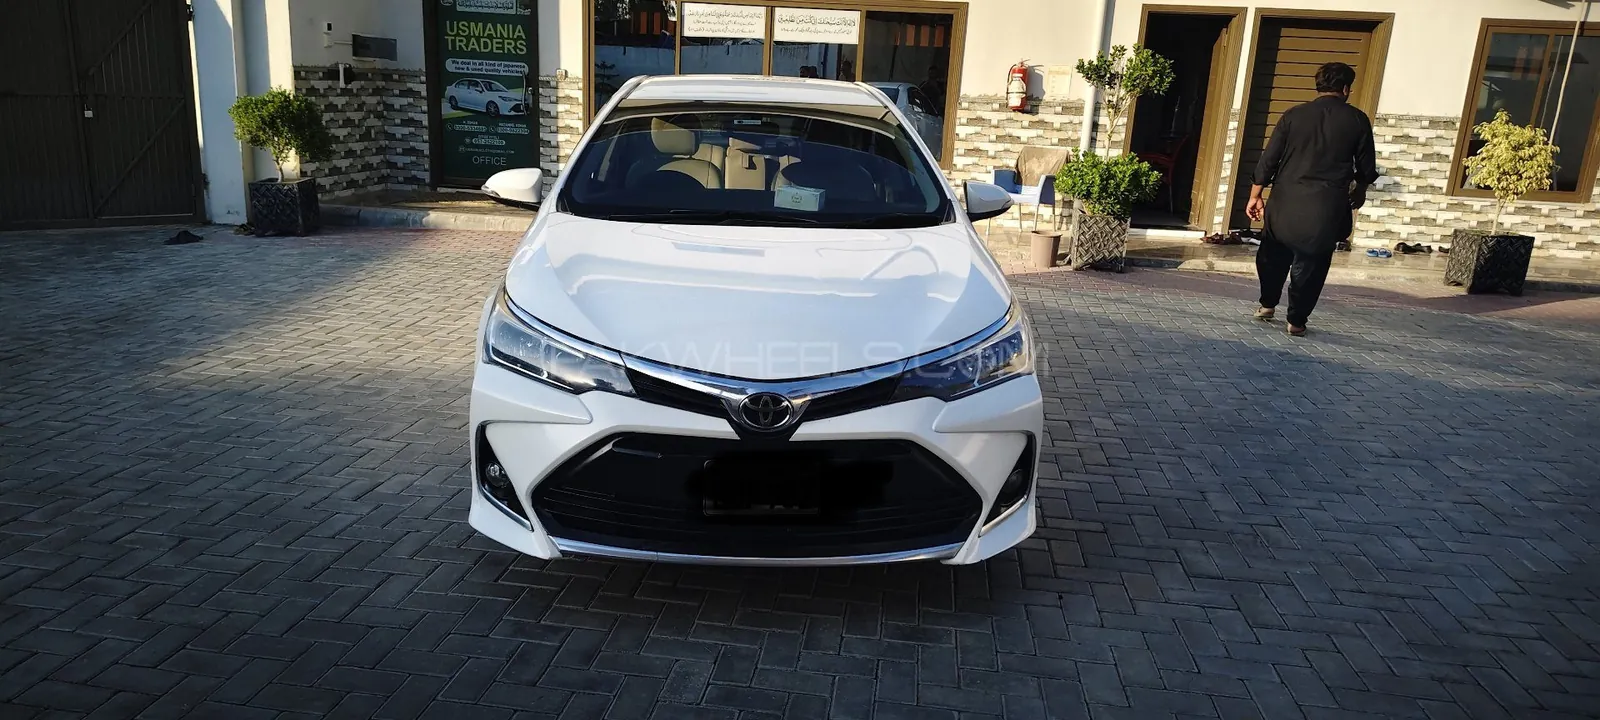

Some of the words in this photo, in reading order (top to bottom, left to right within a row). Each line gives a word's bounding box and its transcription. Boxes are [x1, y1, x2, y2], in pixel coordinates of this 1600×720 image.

[446, 20, 526, 39] USMANIA
[444, 36, 527, 55] TRADERS
[472, 155, 507, 166] OFFICE
